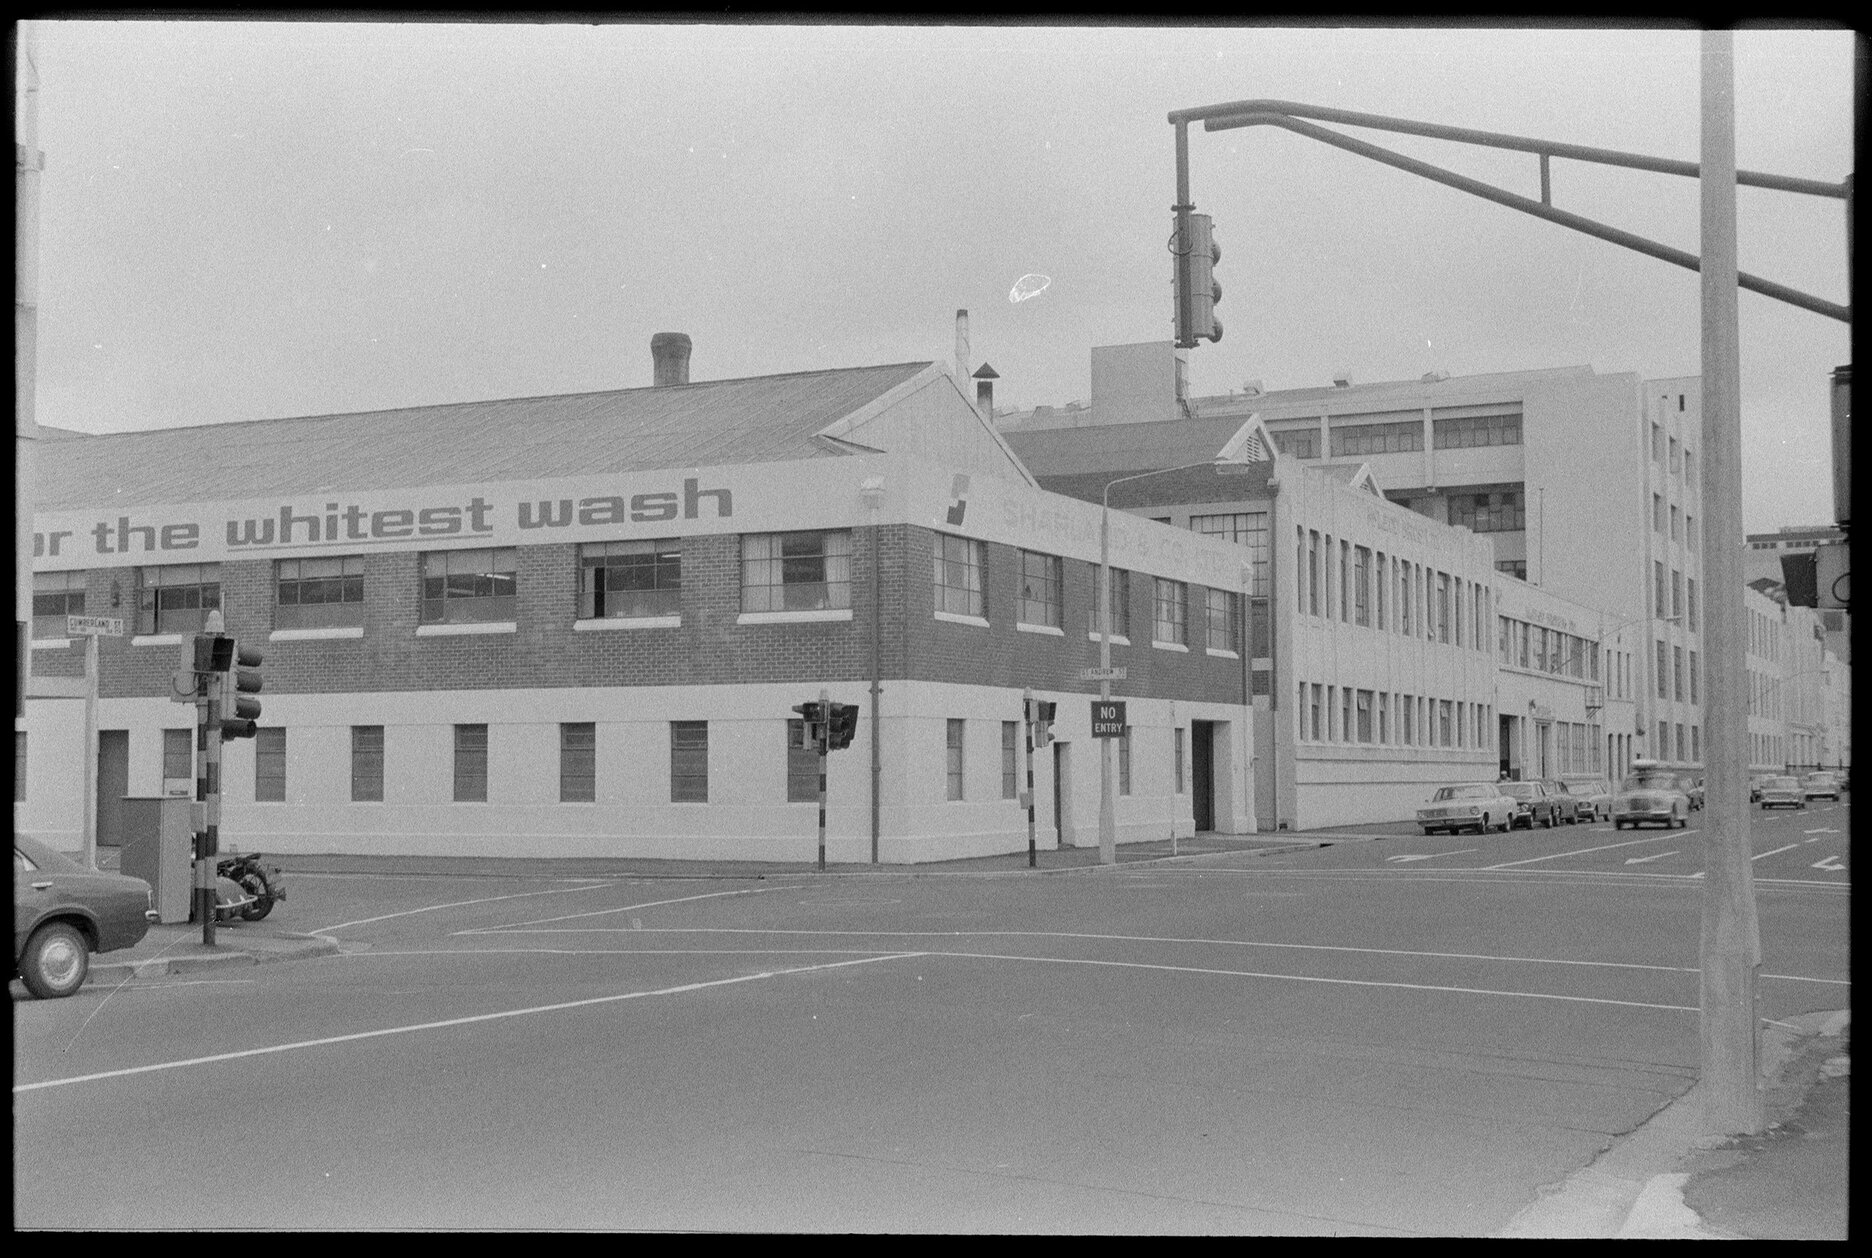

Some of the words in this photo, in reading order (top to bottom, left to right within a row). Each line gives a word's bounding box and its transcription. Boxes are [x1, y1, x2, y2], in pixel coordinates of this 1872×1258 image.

[91, 516, 200, 554] the
[226, 497, 494, 547] whitest
[517, 478, 733, 530] wash
[1100, 706, 1116, 719] NO
[1094, 722, 1123, 733] ENTRY
